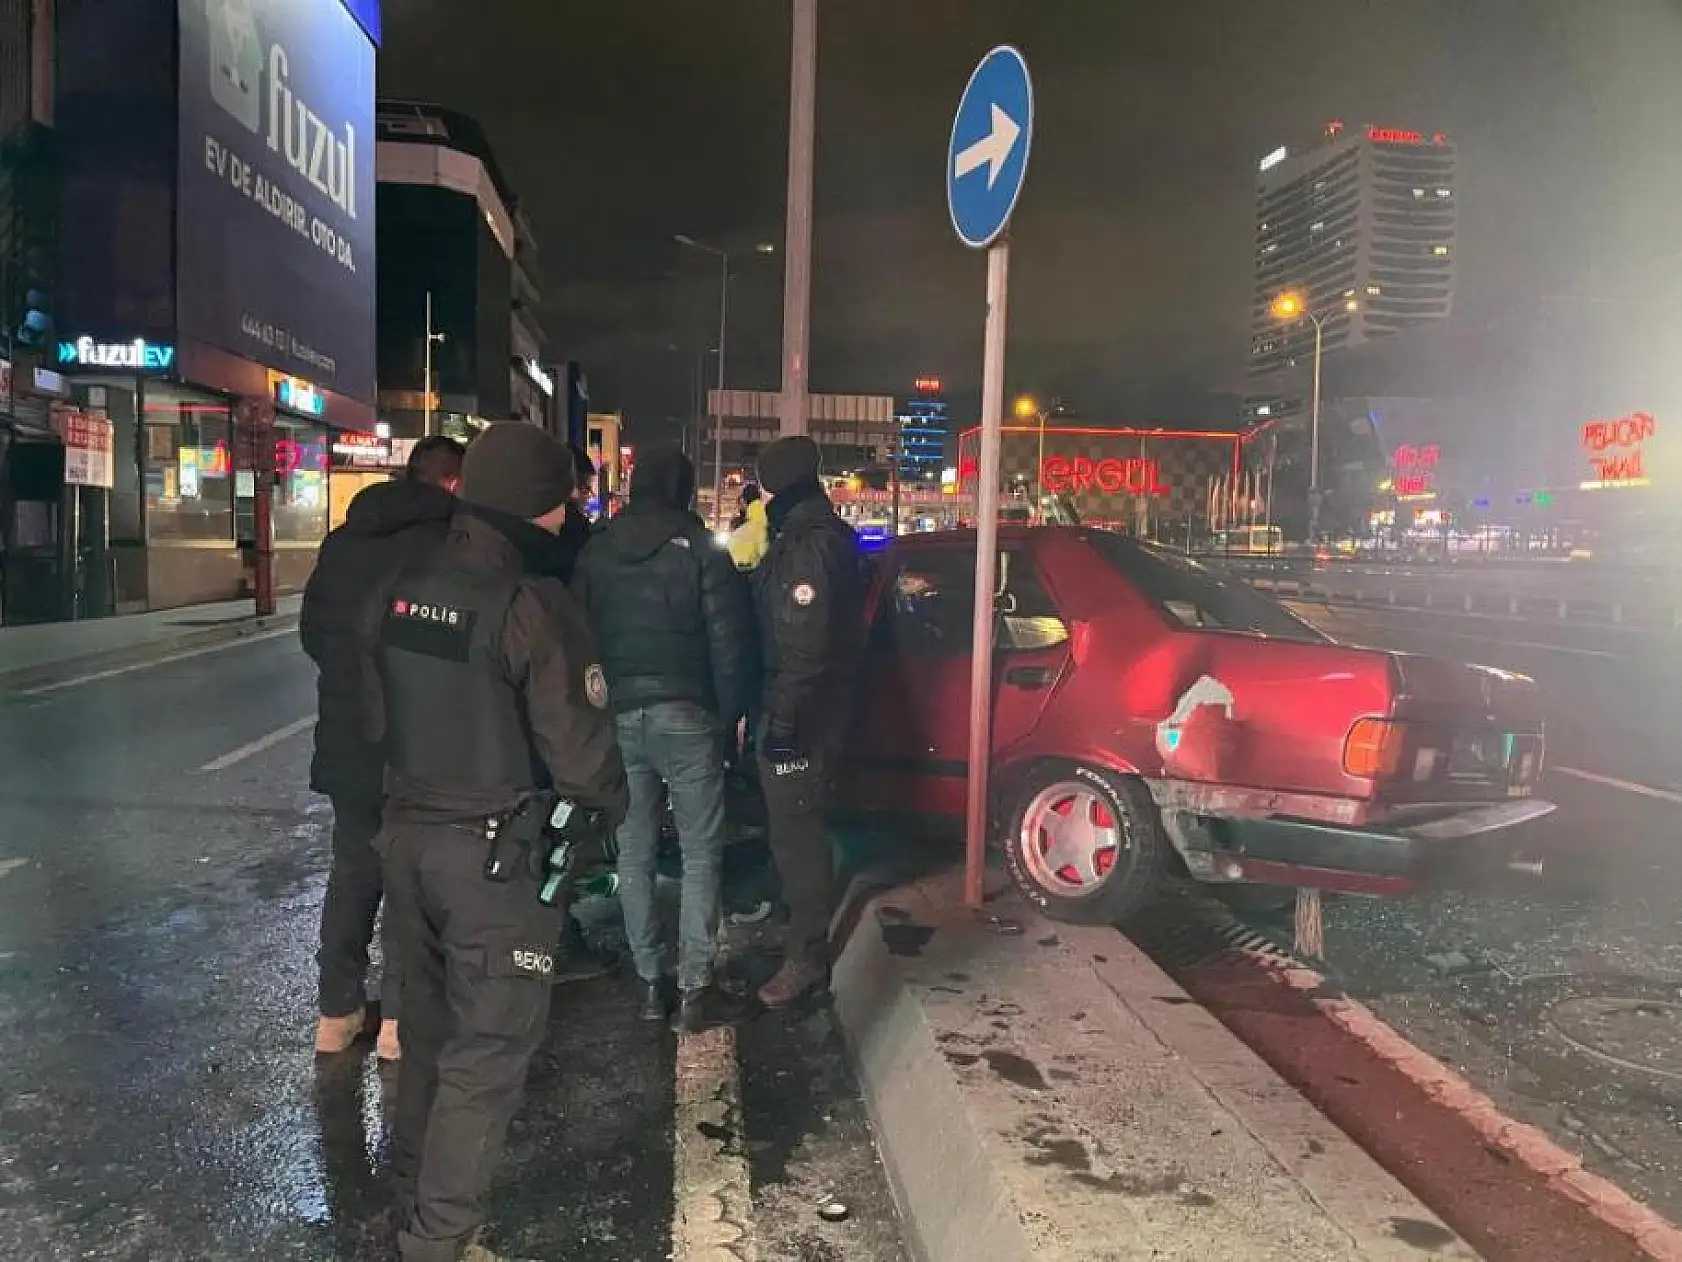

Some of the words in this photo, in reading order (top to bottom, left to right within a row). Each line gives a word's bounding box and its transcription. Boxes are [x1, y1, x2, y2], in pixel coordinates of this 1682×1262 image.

[205, 135, 228, 178] EV
[231, 153, 252, 197] DE
[266, 43, 356, 219] fuzul
